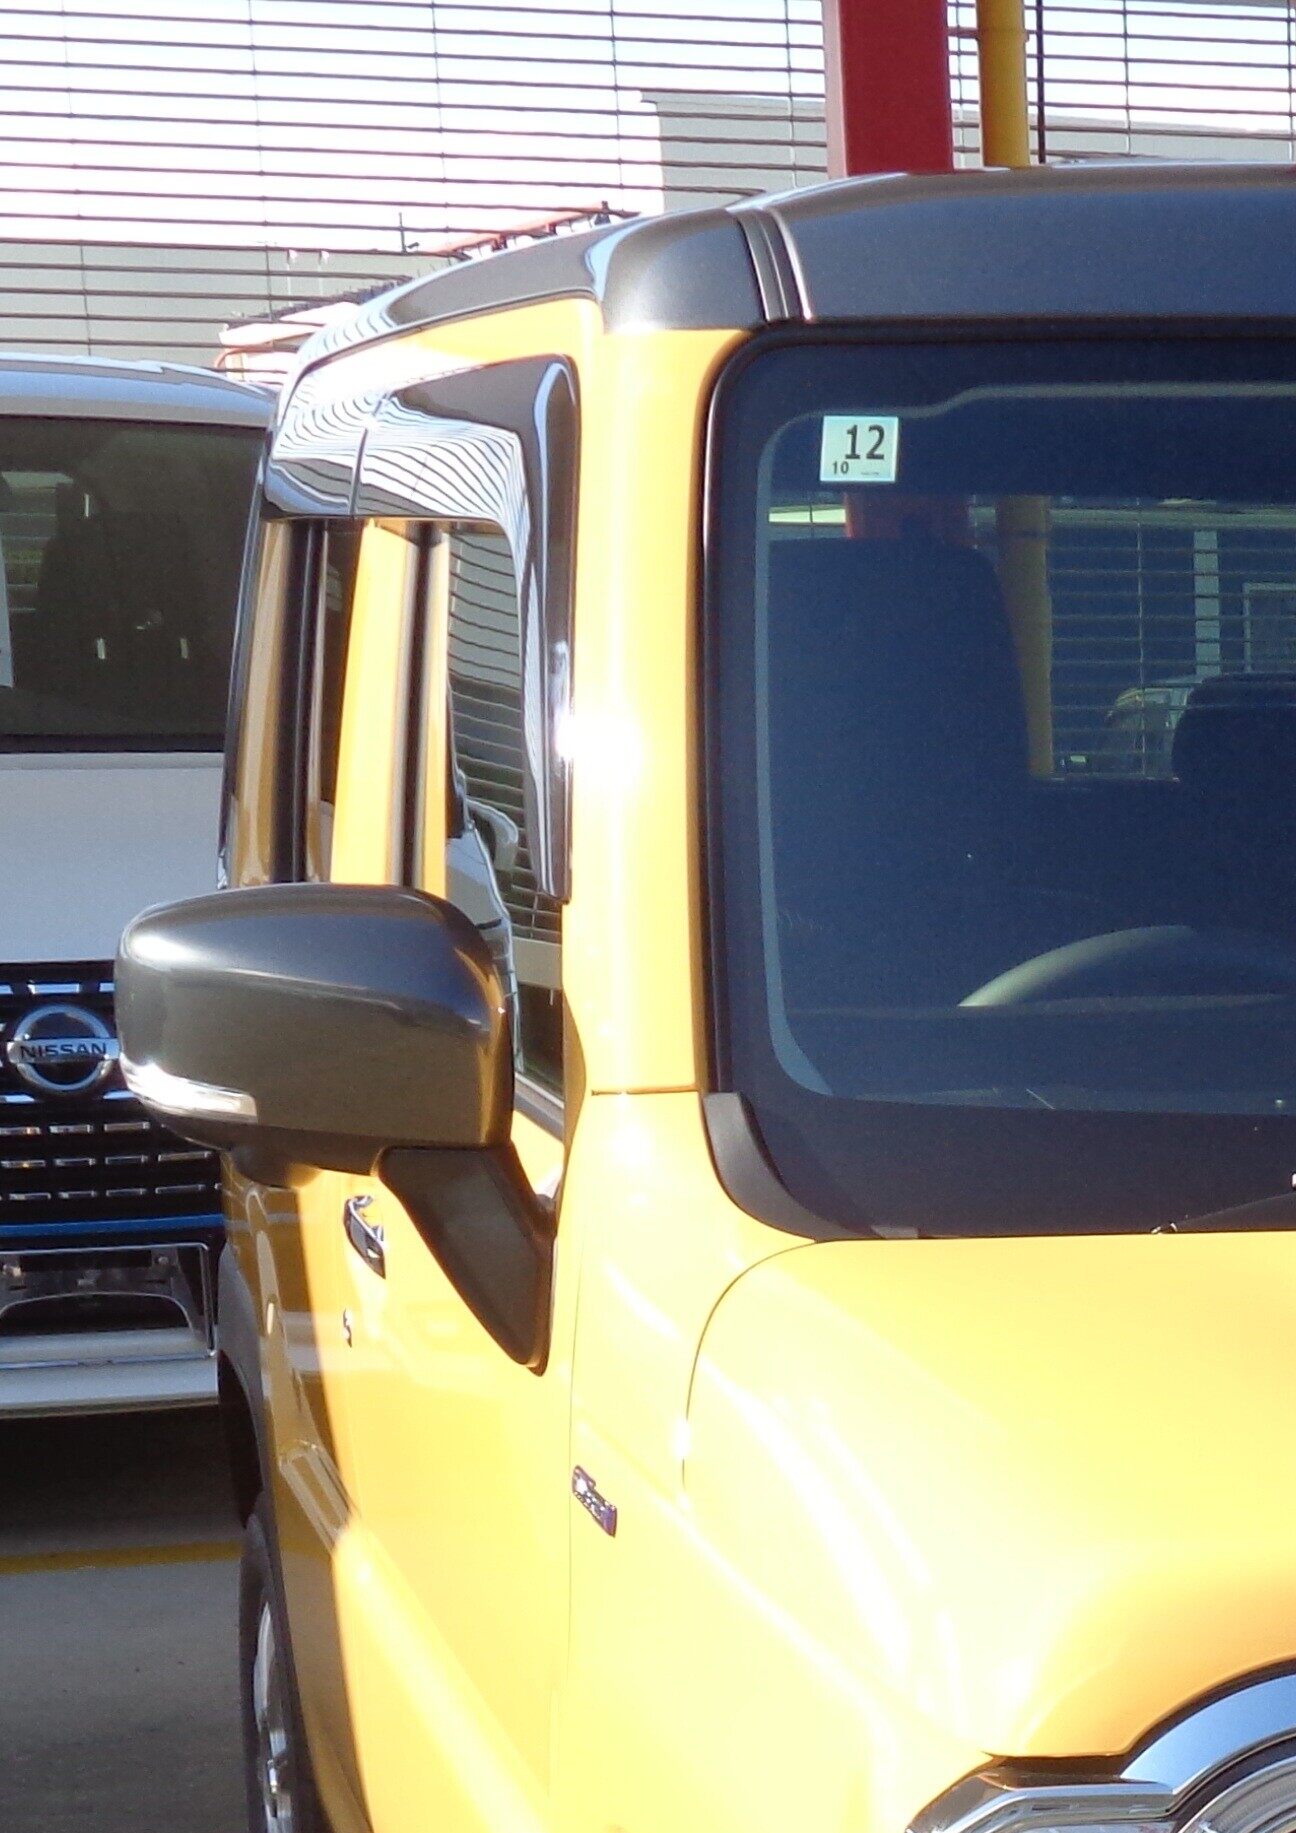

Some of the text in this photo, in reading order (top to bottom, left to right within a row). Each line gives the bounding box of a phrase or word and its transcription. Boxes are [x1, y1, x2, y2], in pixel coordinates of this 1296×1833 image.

[845, 424, 885, 460] 12
[832, 461, 850, 475] 10
[20, 1042, 107, 1060] NISSAN
